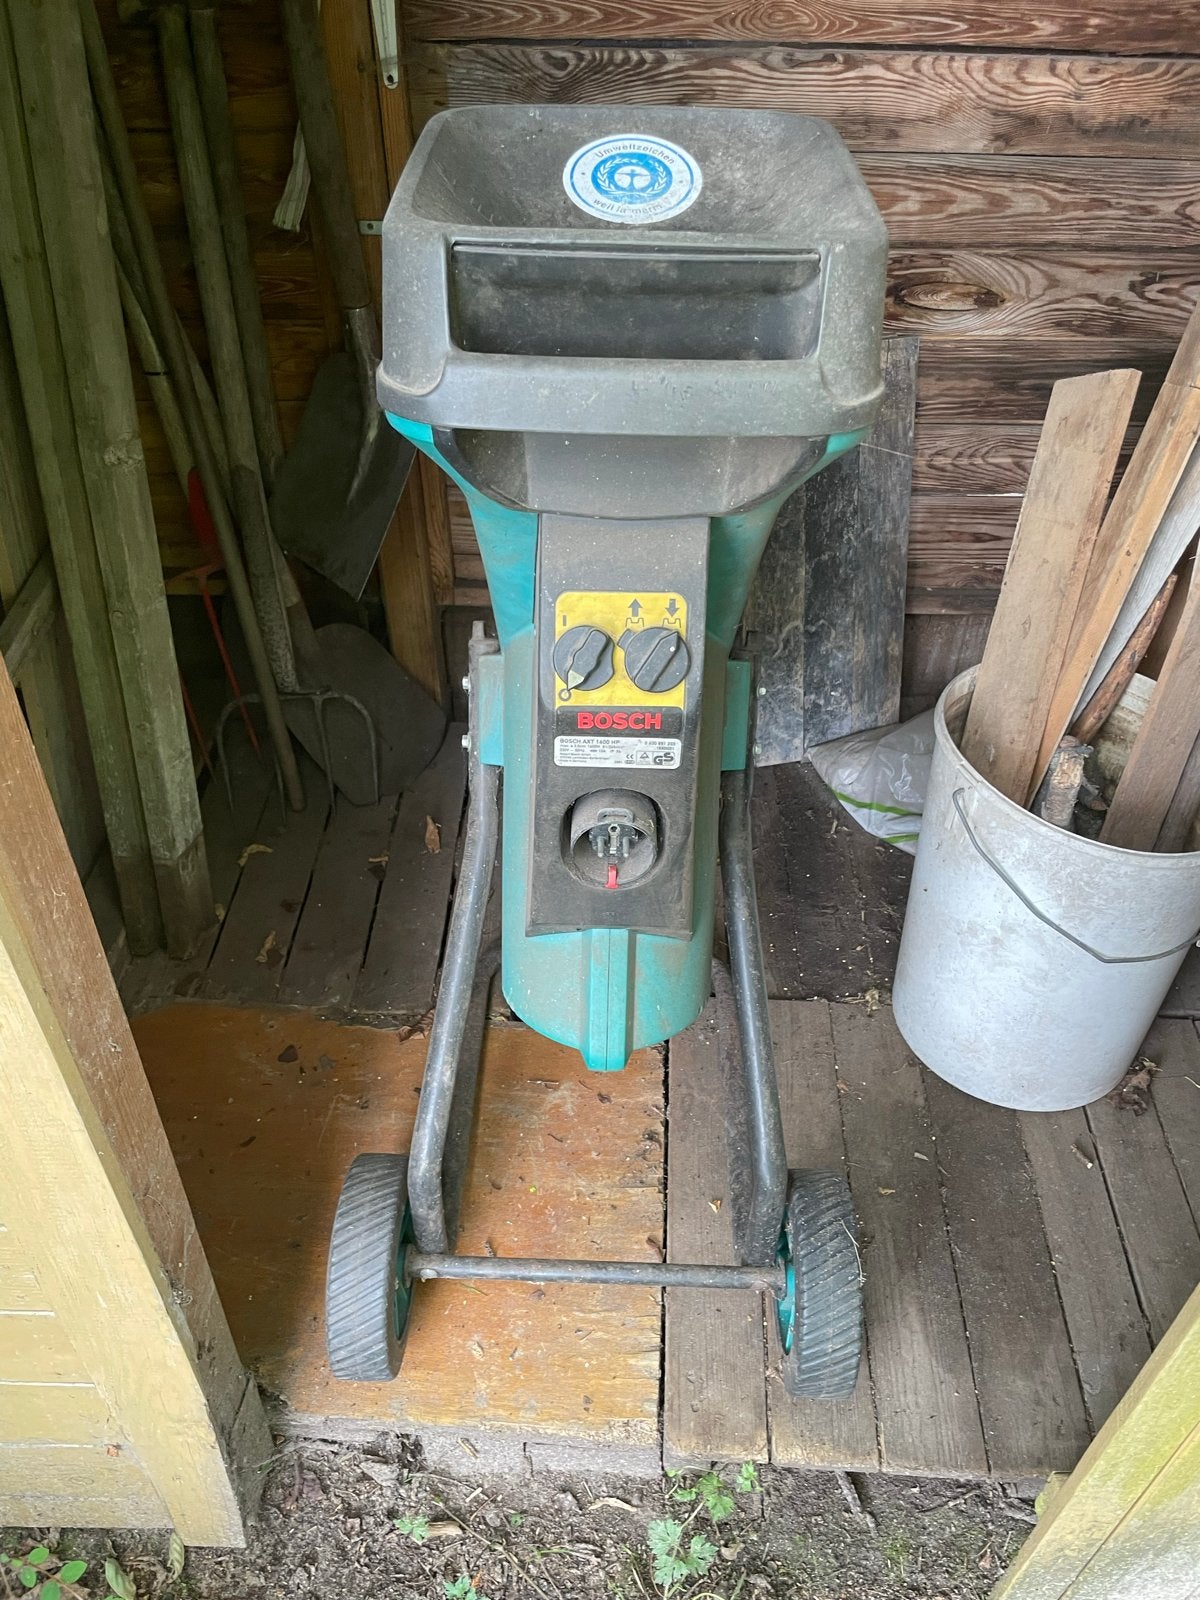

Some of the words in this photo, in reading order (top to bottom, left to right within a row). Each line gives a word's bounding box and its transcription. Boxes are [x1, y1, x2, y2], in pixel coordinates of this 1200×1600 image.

[595, 143, 675, 165] Umweltzeichen
[577, 712, 662, 730] BOSCH
[654, 752, 674, 766] GS
